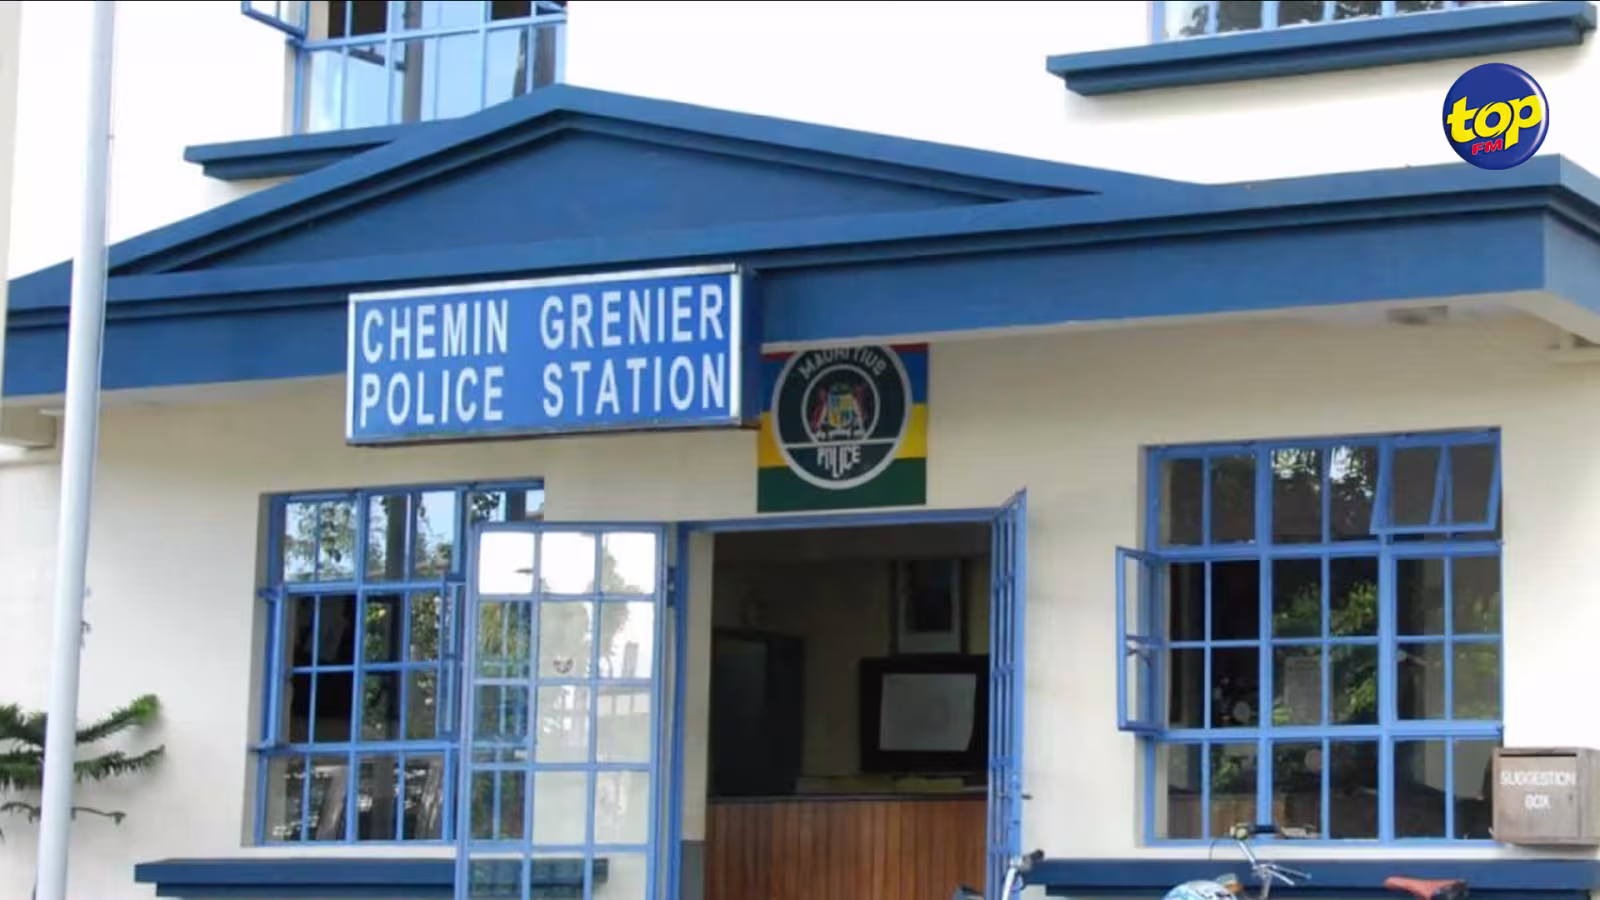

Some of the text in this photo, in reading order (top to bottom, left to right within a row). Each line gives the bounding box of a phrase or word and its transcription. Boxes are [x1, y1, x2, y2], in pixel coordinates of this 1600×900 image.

[362, 284, 723, 363] CHEMIN GRENIER
[359, 352, 725, 427] POLICE STATION
[1500, 771, 1576, 786] SUGGESTION
[1525, 794, 1551, 810] BOX
